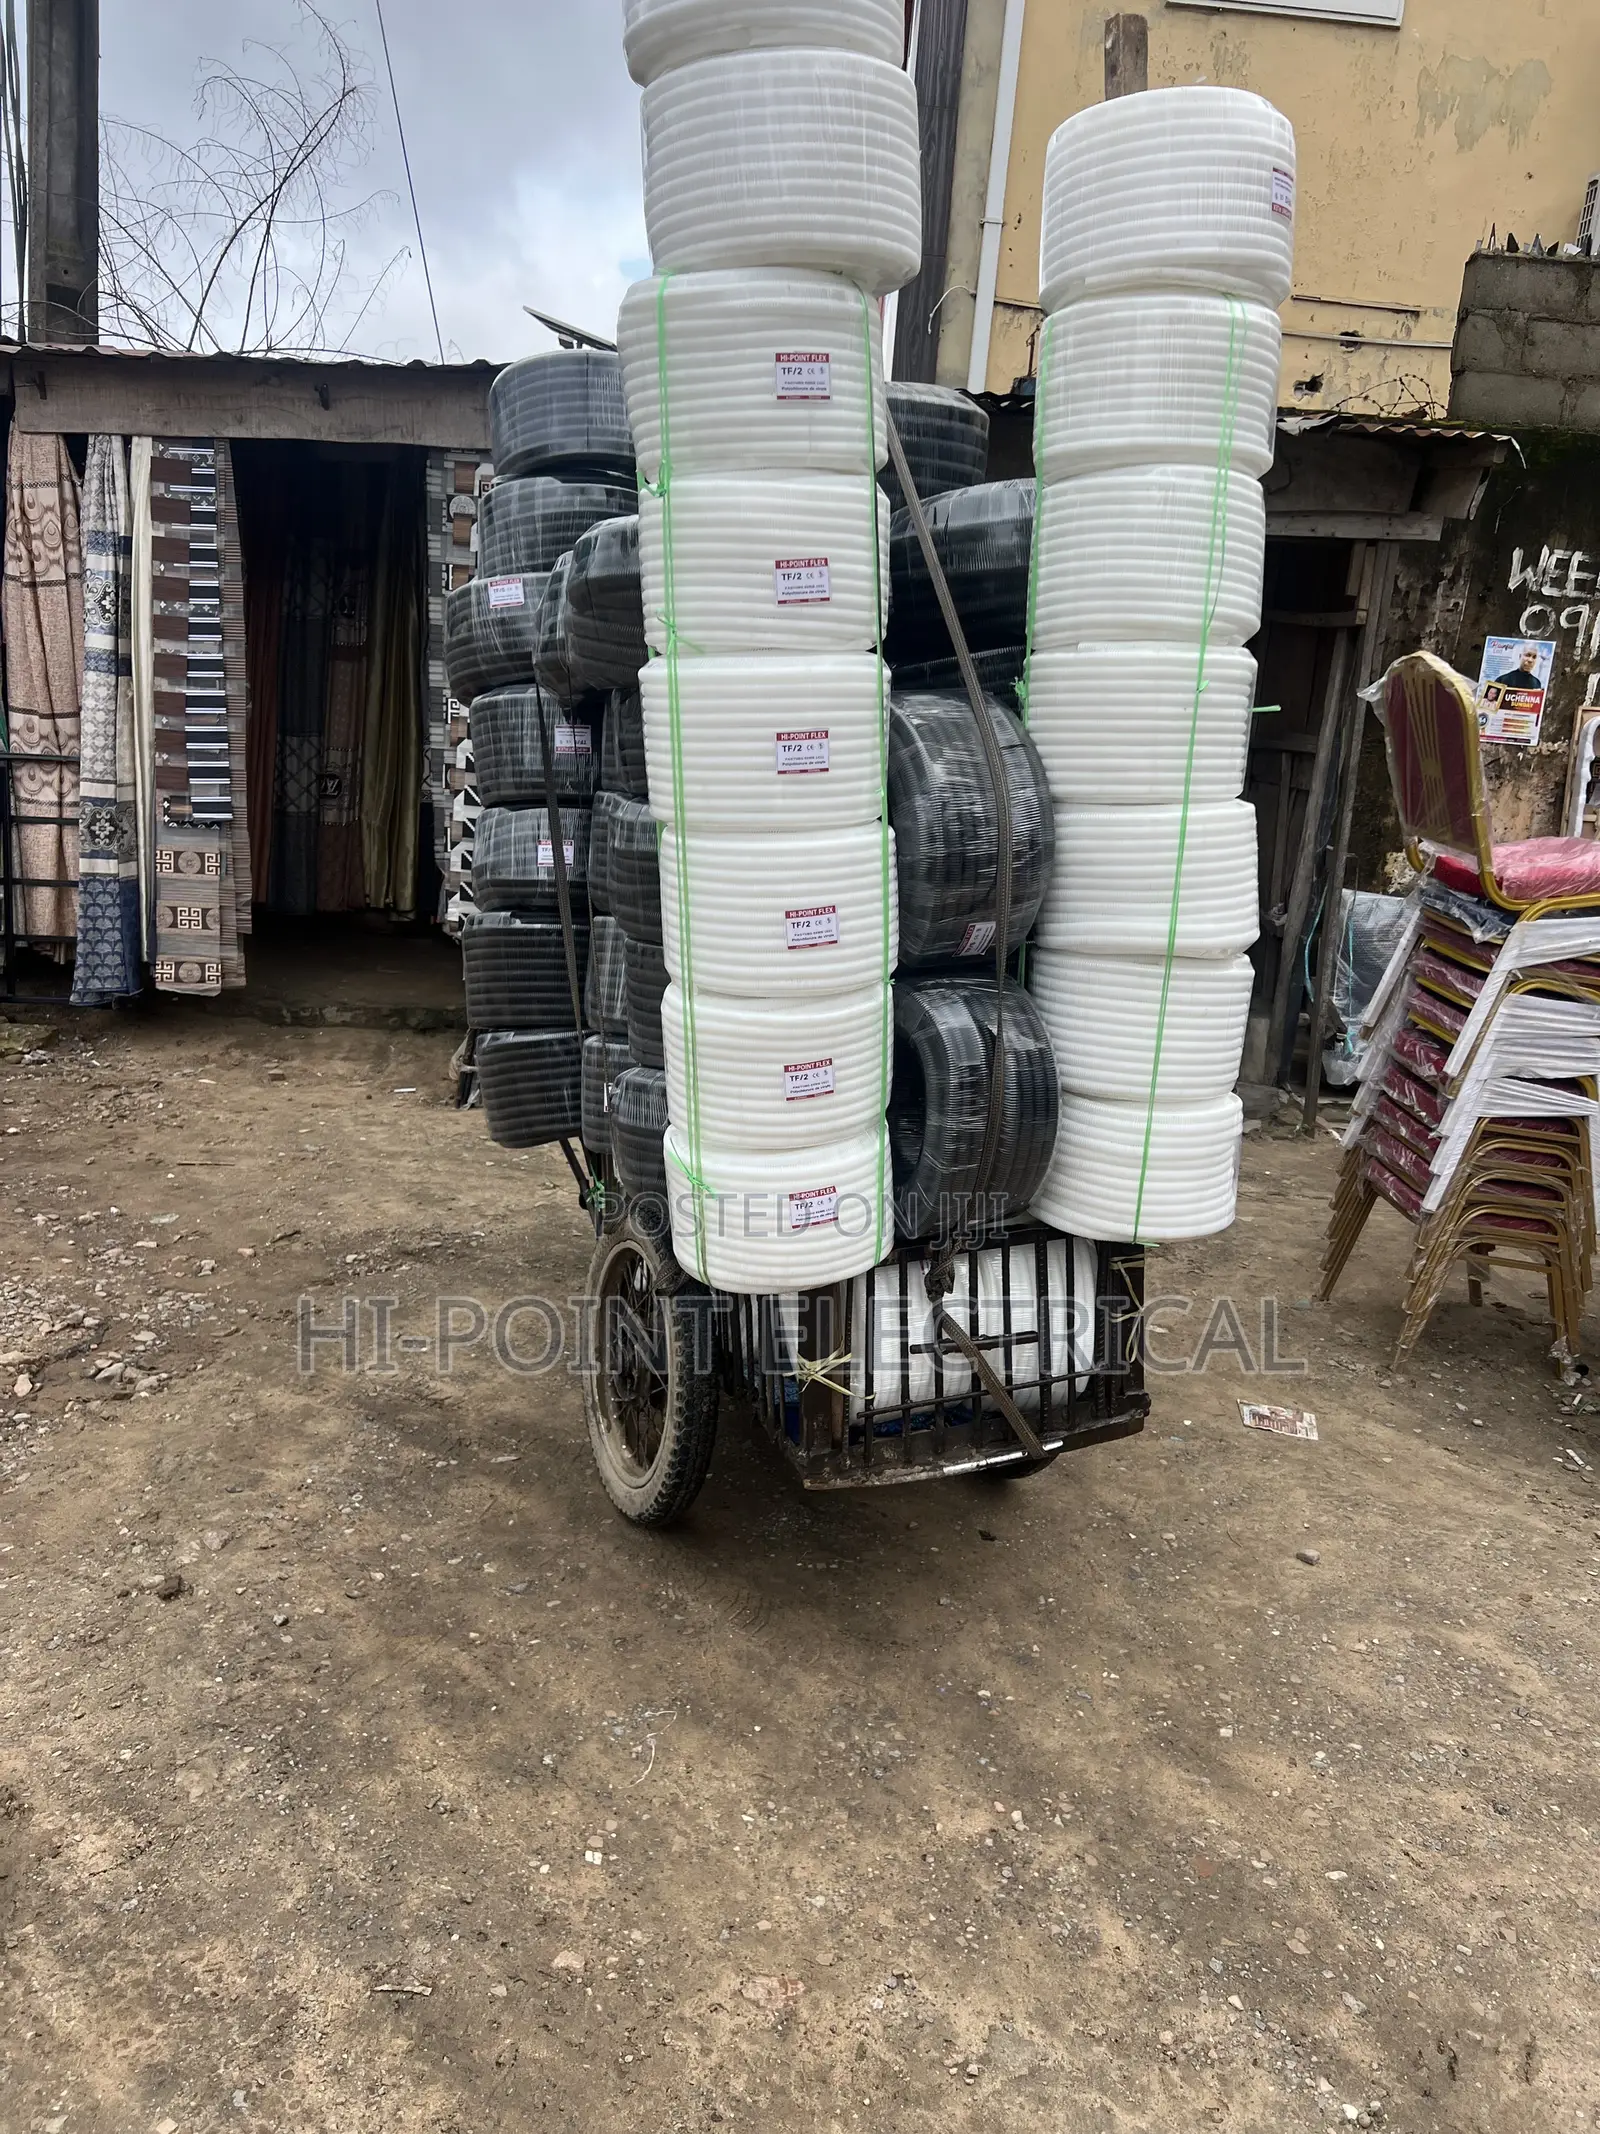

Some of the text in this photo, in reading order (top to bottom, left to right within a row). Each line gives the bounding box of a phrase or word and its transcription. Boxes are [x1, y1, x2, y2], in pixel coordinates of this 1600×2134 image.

[781, 367, 802, 375] TF/2
[781, 558, 826, 568] HI-POINT FLEX
[781, 572, 802, 580] TF/2
[1507, 544, 1600, 600] WEE
[1504, 693, 1540, 704] UCHENNA
[782, 744, 802, 752] TF/2
[790, 906, 833, 917] HI-POINT FLEX
[788, 1059, 830, 1071] HI-POINT FLEX
[820, 1187, 834, 1195] FLEX
[795, 1202, 813, 1210] TF/2
